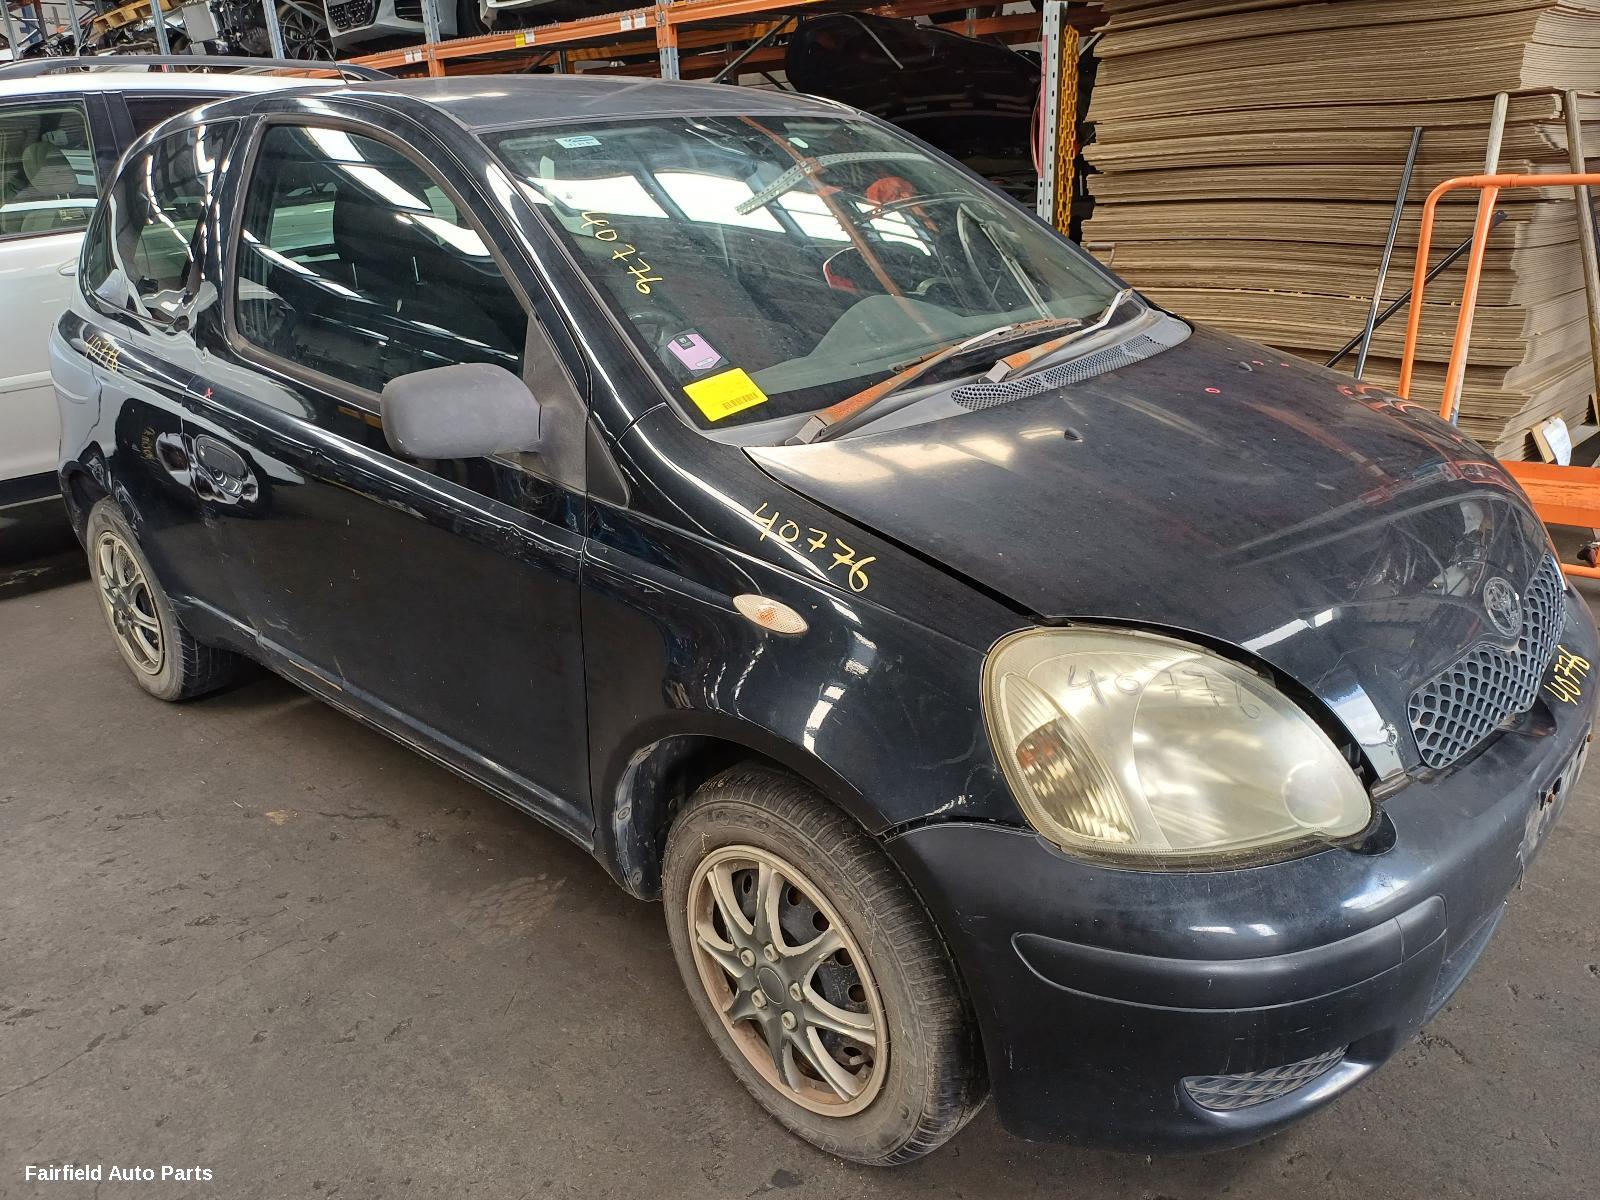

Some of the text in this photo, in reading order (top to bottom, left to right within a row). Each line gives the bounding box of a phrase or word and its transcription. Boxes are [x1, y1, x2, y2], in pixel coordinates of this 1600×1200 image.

[581, 211, 663, 295] 40776
[752, 502, 877, 593] 40776
[1067, 663, 1261, 720] 40776
[1543, 644, 1591, 706] 40776
